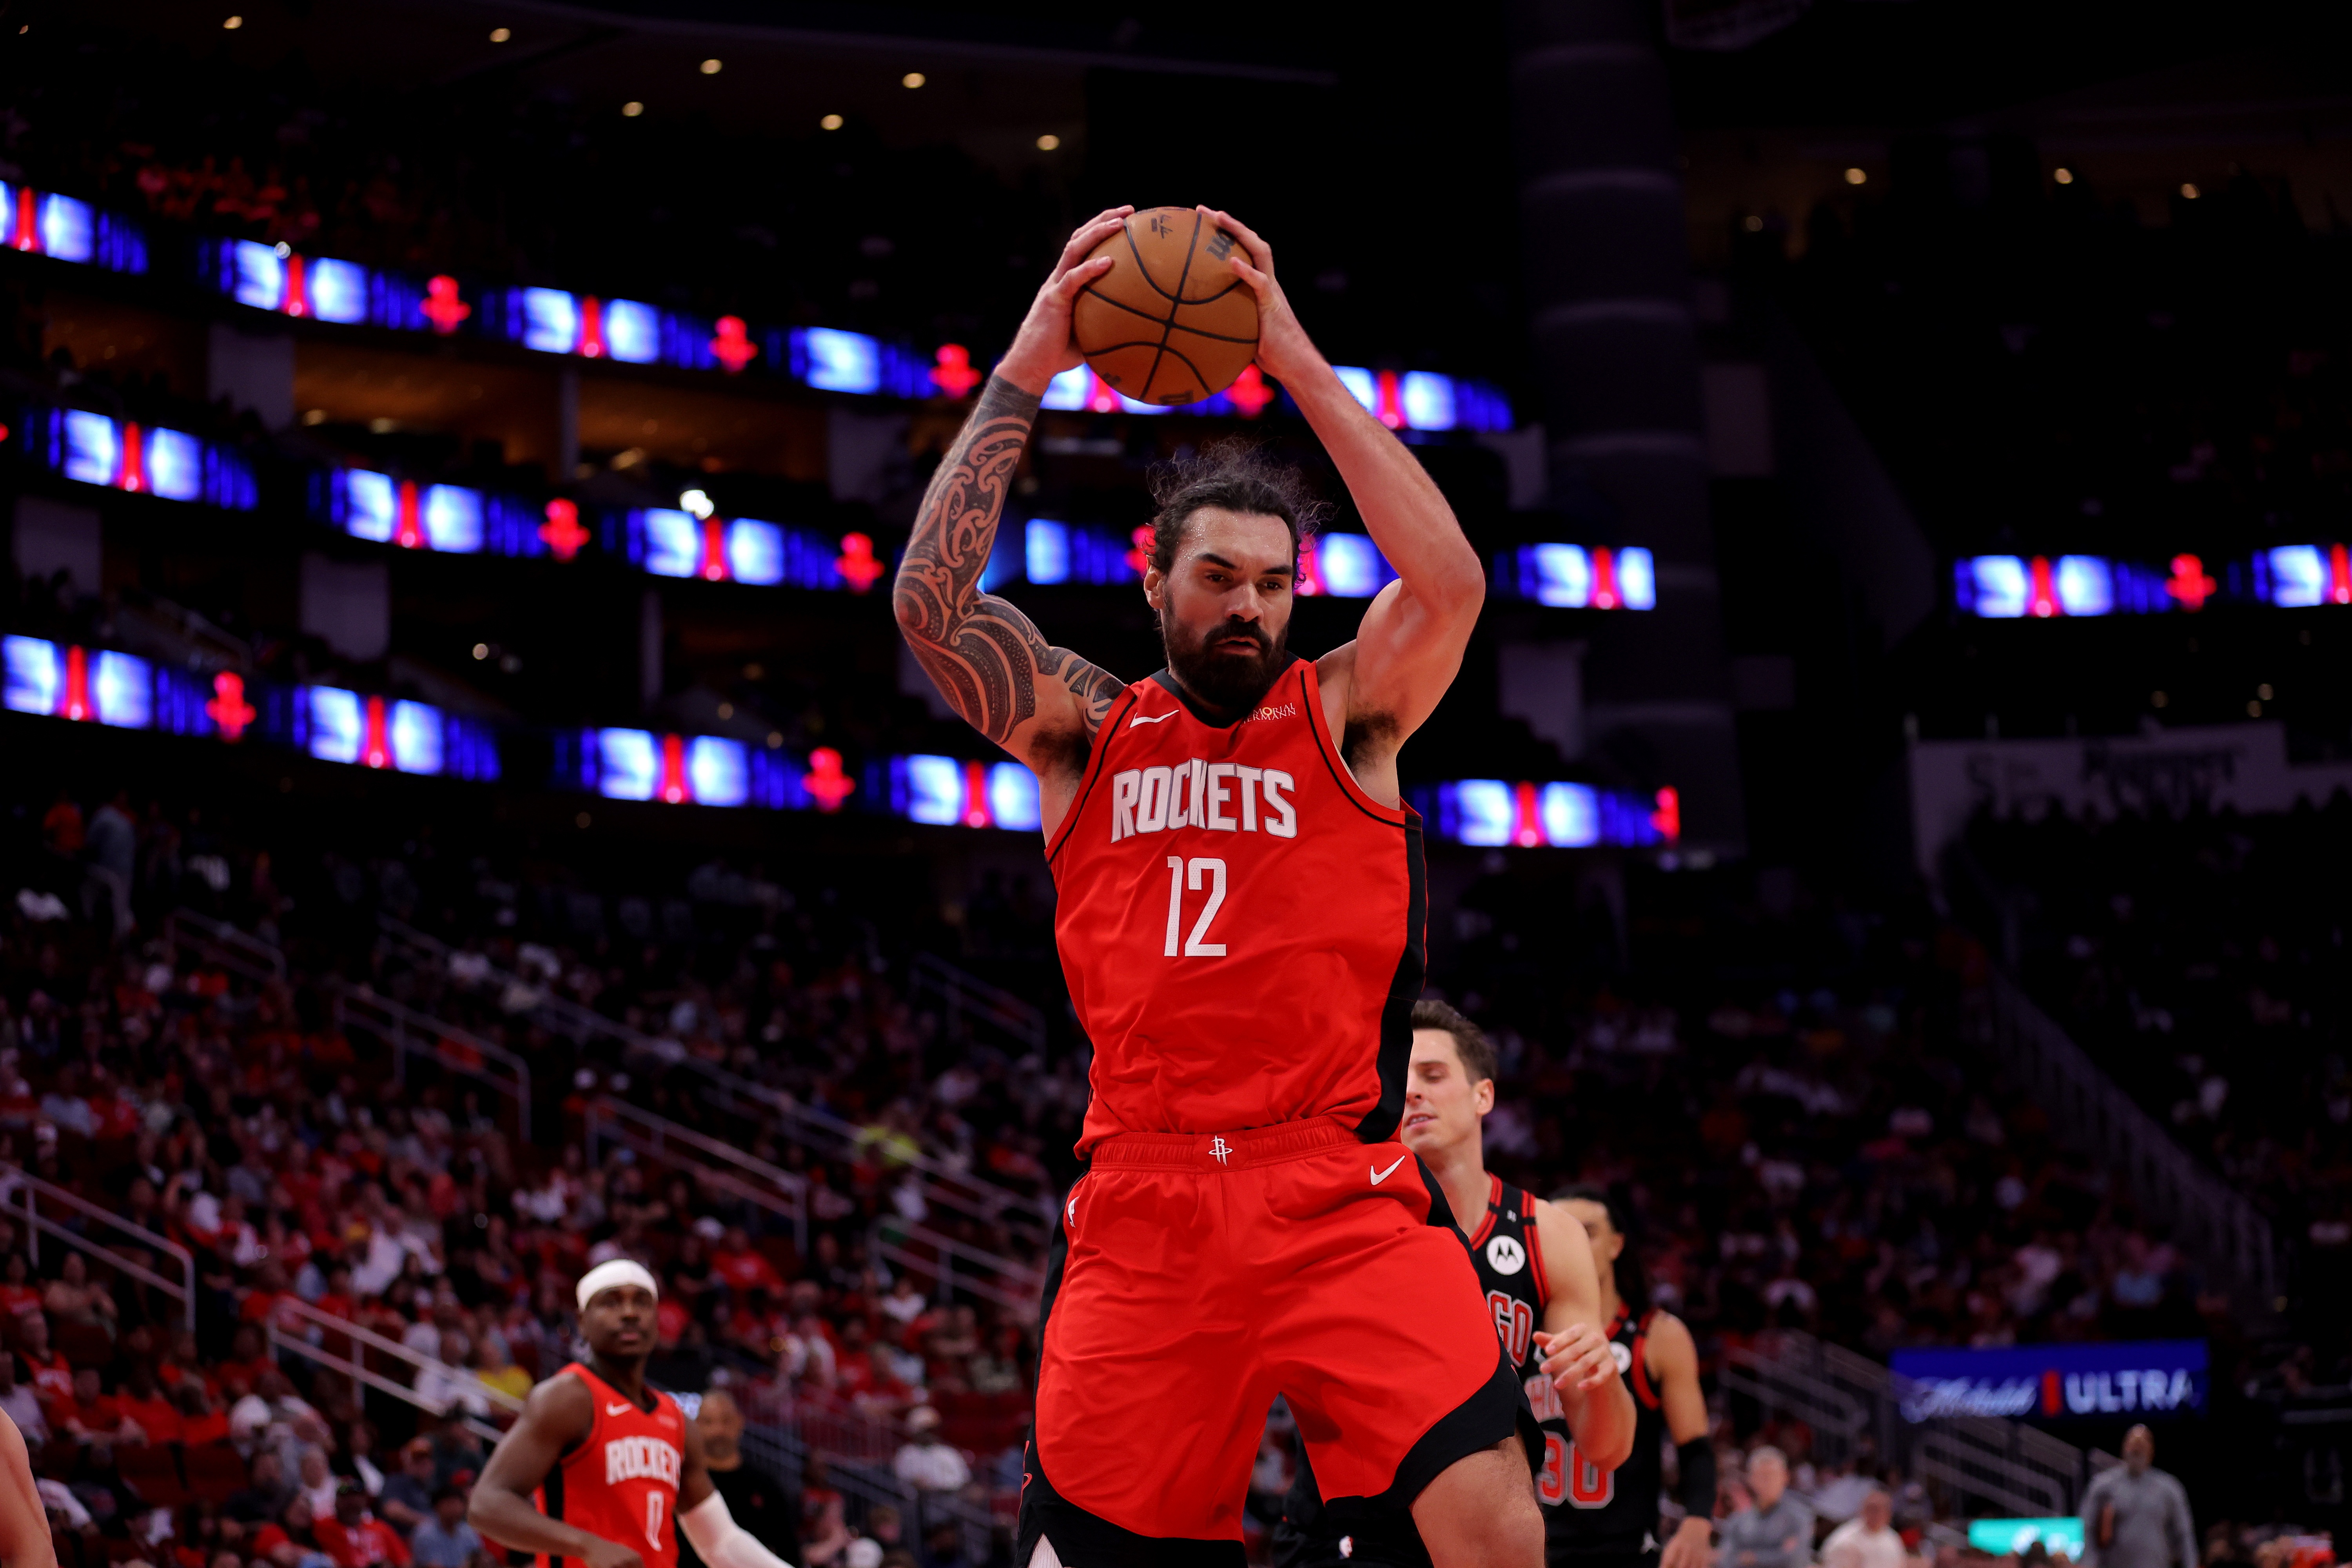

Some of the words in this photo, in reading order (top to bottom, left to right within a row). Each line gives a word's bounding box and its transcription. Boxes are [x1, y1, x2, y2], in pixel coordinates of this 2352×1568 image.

[1240, 708, 1296, 727] ERMANN
[1111, 757, 1298, 844] ROCKETS
[1164, 856, 1227, 956] 12
[2065, 1367, 2200, 1414] ULTRA
[1534, 1431, 1615, 1509] 30
